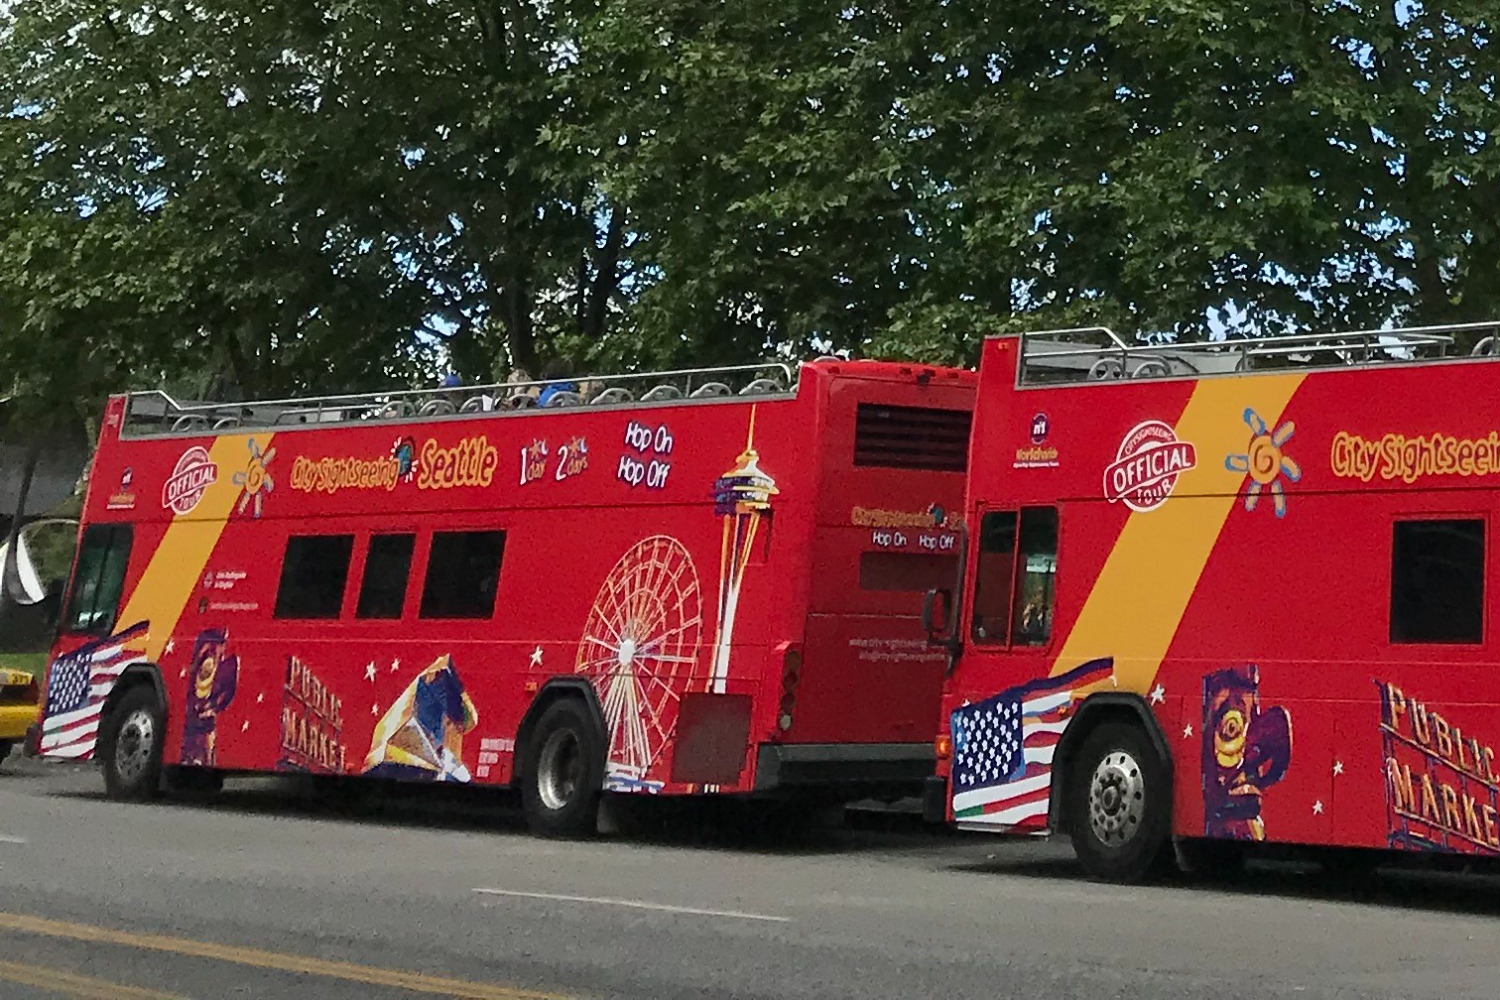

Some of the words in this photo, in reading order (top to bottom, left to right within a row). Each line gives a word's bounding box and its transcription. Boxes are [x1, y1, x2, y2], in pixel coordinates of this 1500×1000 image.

[625, 422, 652, 452] Hop
[654, 426, 673, 453] On
[417, 435, 499, 490] Seattle
[527, 458, 546, 481] day
[555, 445, 568, 480] 2
[618, 456, 644, 486] Hop
[647, 460, 671, 488] Off
[1113, 446, 1191, 493] OFFICIAL
[168, 467, 215, 500] OFFICIAL
[1137, 478, 1172, 505] TOUR
[872, 531, 891, 547] Hop
[894, 532, 907, 546] On
[919, 535, 937, 549] Hop
[939, 535, 955, 549] Off
[290, 656, 343, 728] PUBLIC
[282, 708, 346, 771] MARKET
[1387, 682, 1500, 784] PUBLIC
